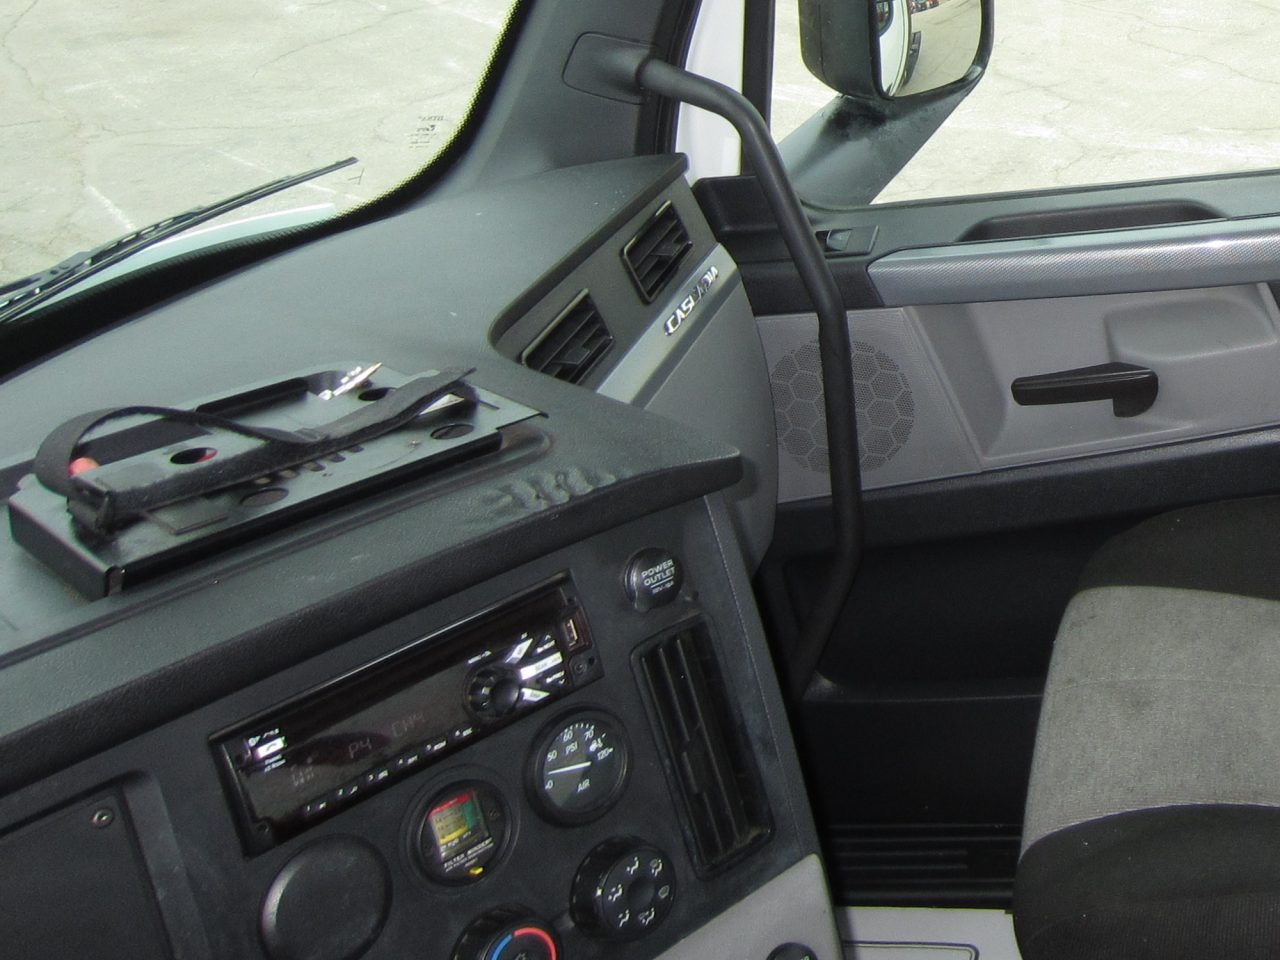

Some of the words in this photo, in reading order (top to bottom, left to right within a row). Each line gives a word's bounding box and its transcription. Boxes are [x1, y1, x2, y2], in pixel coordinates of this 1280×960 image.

[641, 559, 674, 579] POWER
[644, 567, 676, 587] OUTLET
[563, 730, 574, 742] 60
[584, 730, 595, 741] 70
[565, 741, 579, 755] PSI
[597, 747, 610, 760] 120
[577, 778, 590, 793] AIR
